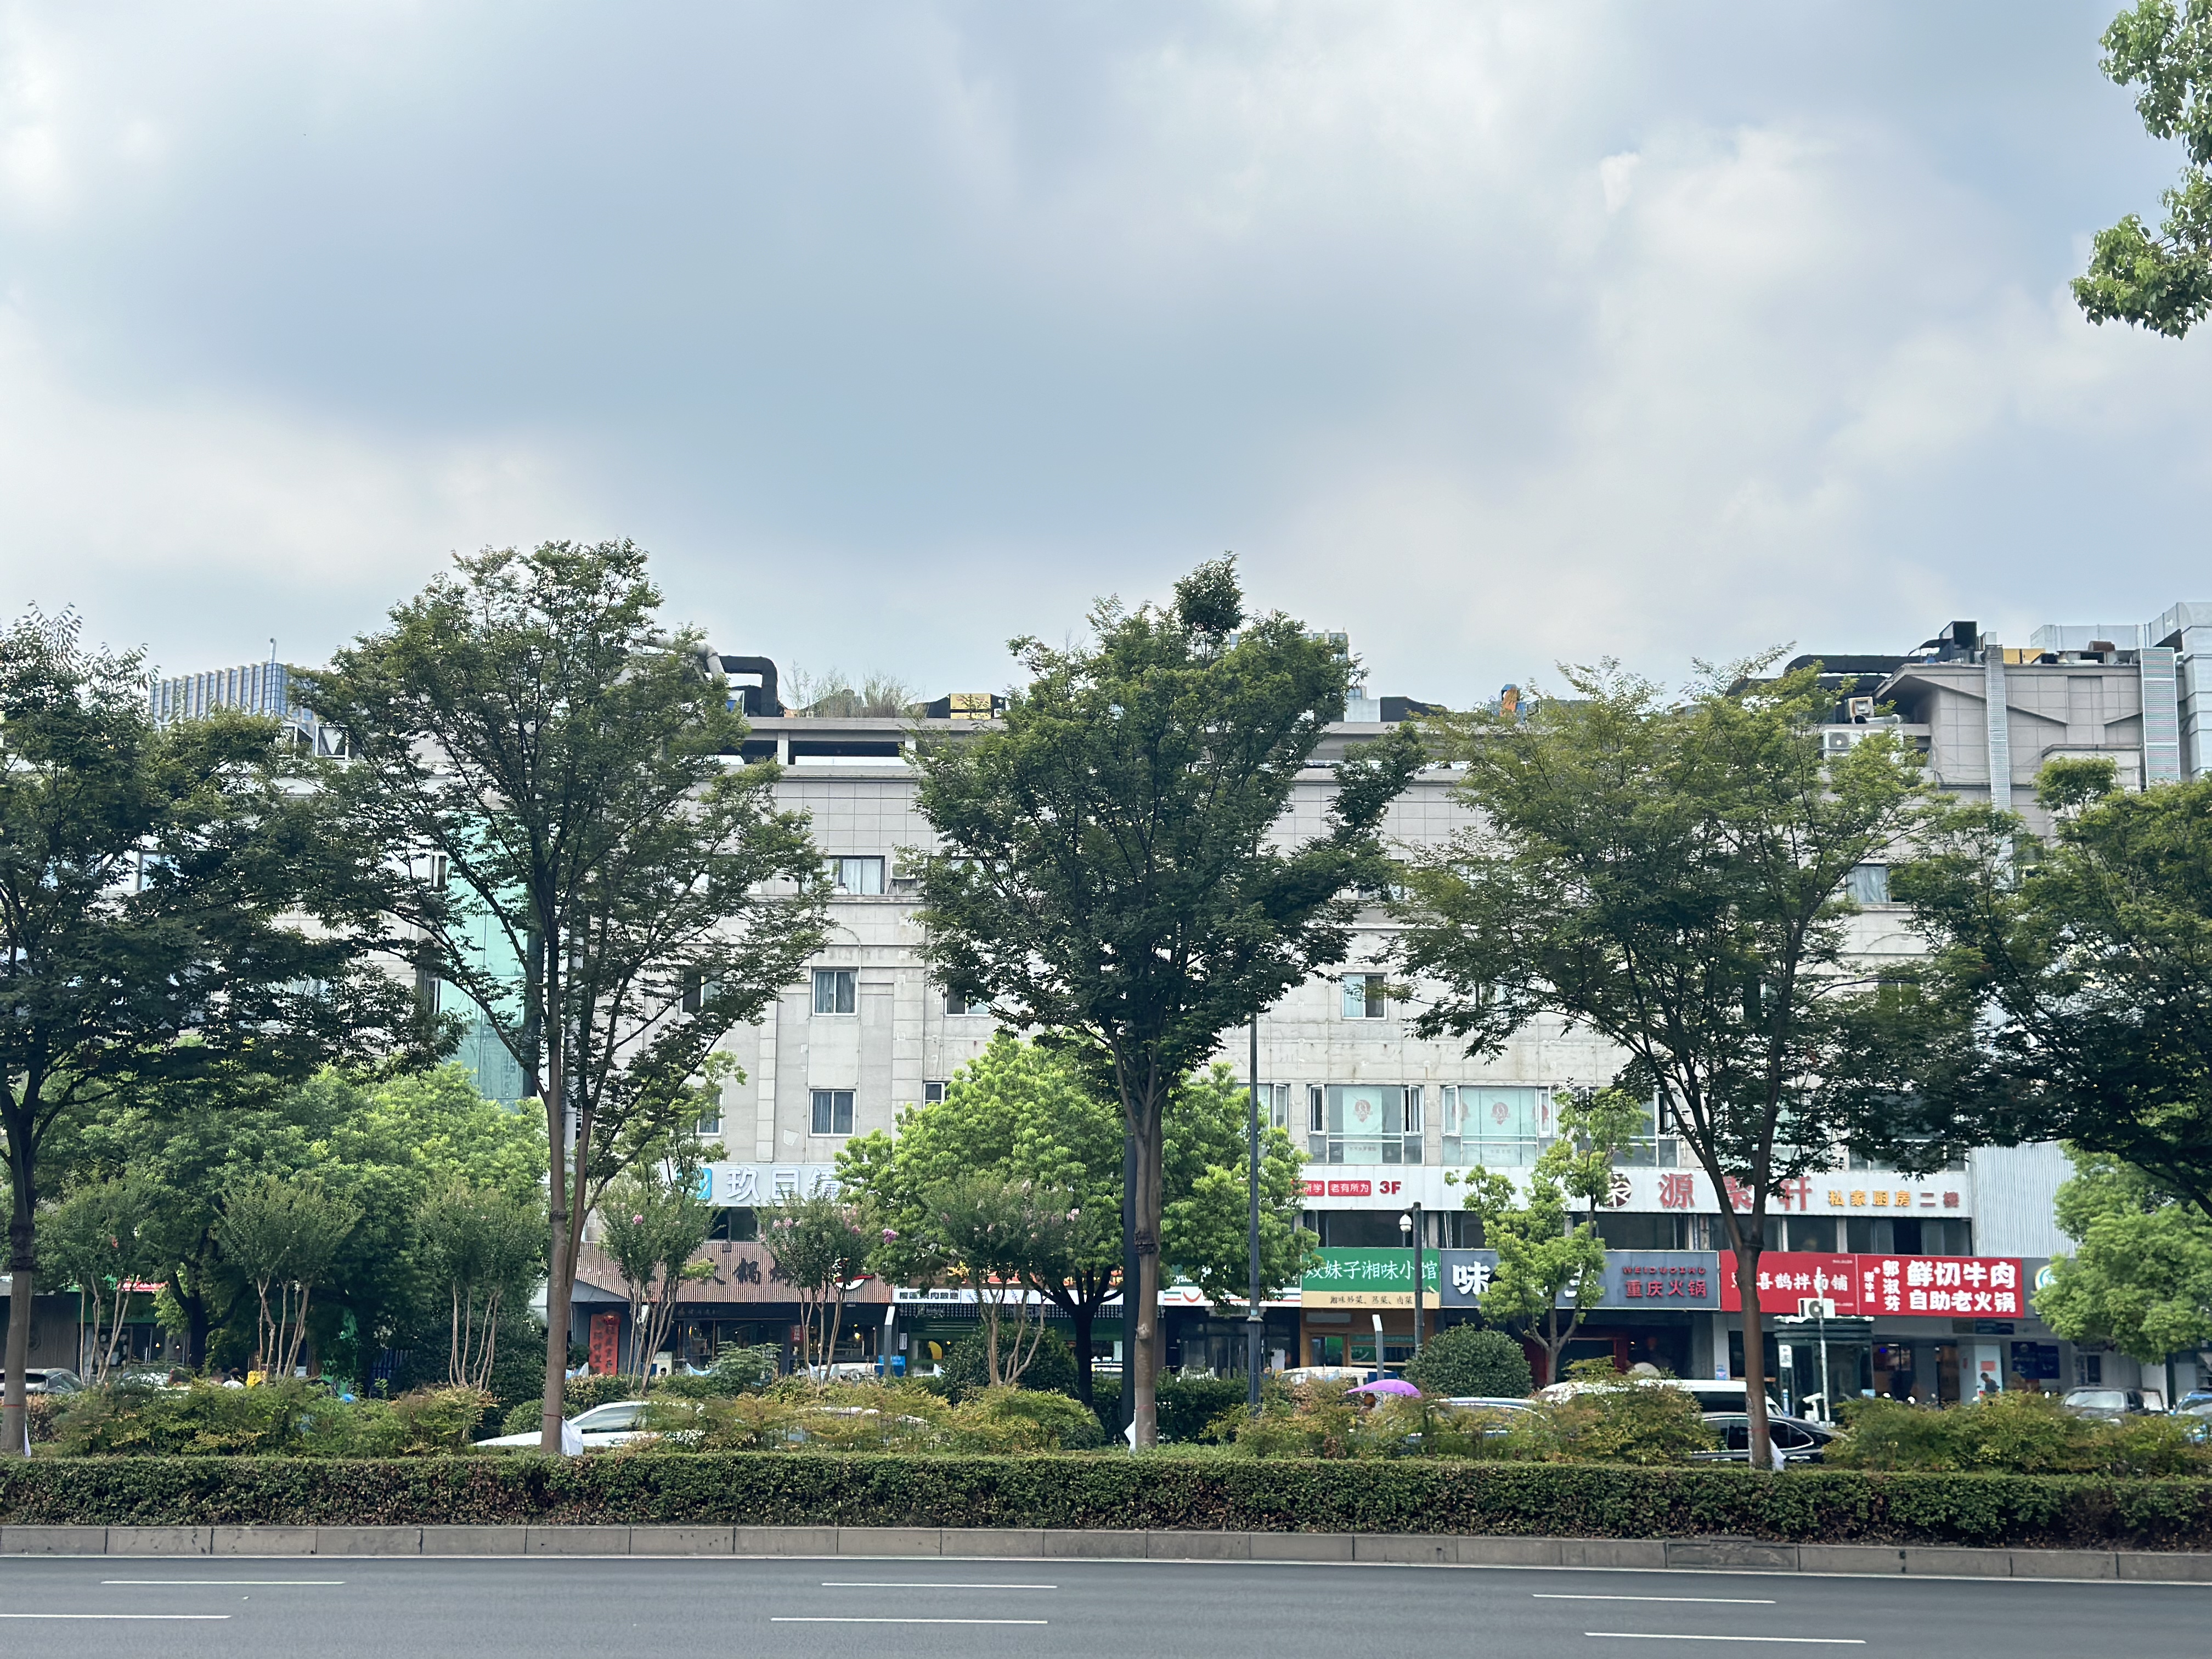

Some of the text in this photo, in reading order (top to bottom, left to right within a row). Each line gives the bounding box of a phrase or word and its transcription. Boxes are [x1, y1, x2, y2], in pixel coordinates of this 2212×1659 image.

[1330, 1183, 1370, 1193] 老有所为
[1379, 1181, 1402, 1194] 3F
[1829, 1189, 1911, 1206] 私家厨房
[1906, 1260, 2016, 1289] 鲜切牛肉
[1626, 1279, 1707, 1298] 重庆火锅
[1909, 1289, 2016, 1313] 自助老火锅
